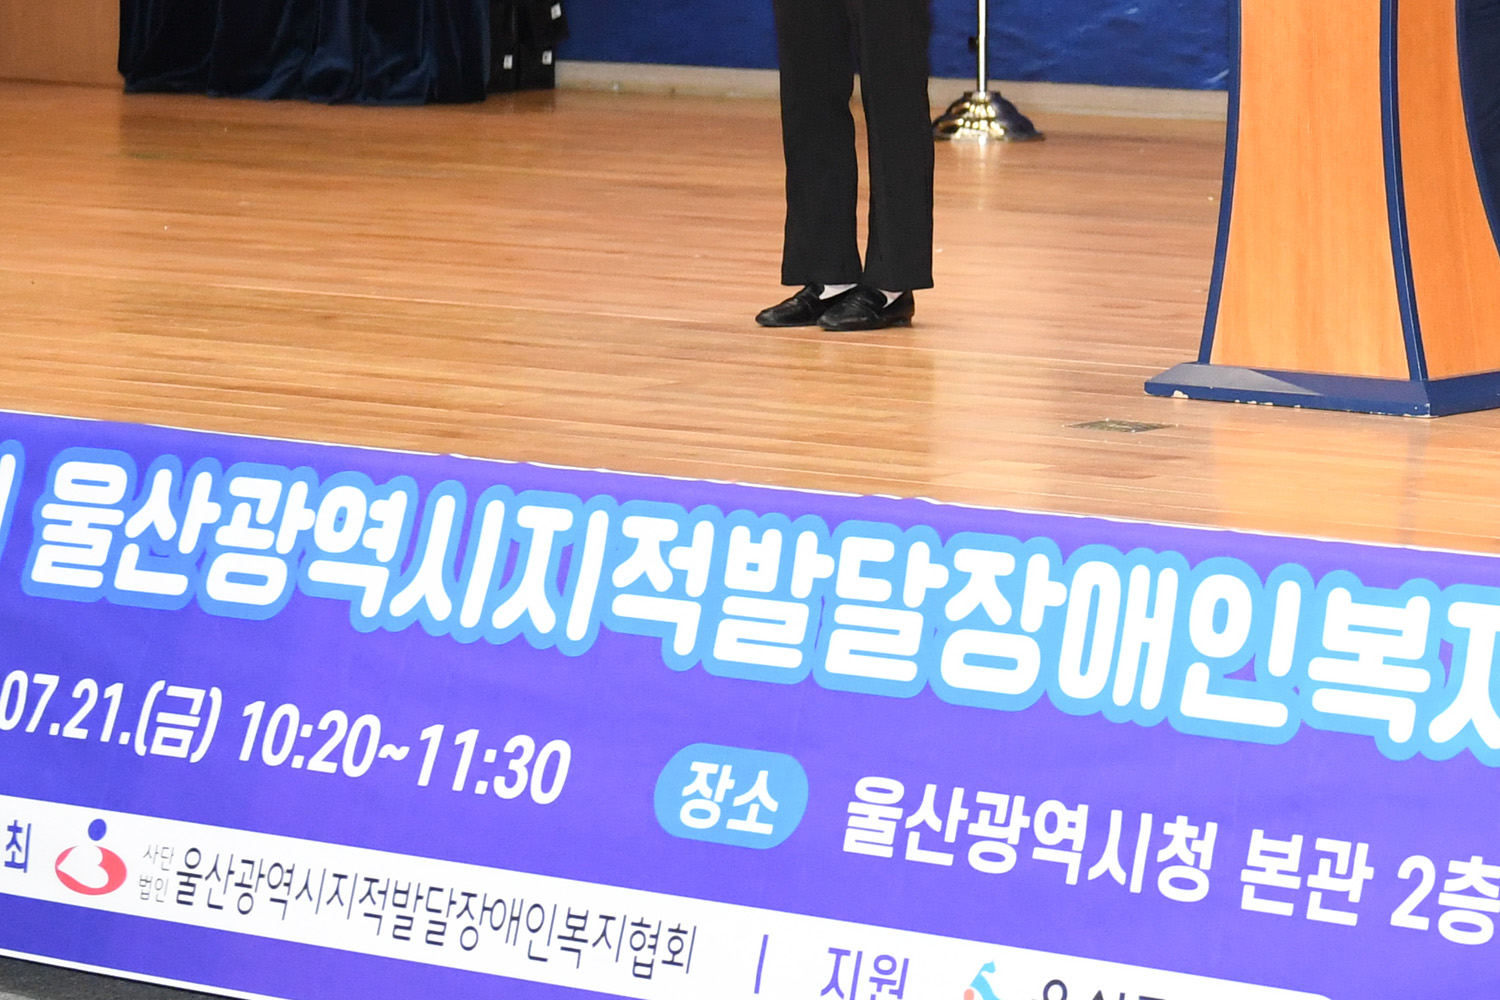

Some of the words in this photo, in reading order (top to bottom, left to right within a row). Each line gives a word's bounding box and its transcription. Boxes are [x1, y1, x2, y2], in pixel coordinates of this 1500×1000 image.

[238, 699, 572, 805] 10:20~11:30
[679, 760, 779, 836] 장소
[138, 873, 170, 903] 법인
[142, 843, 175, 872] 사단
[842, 776, 1218, 903] 울산광역시청
[1240, 828, 1375, 927] 본관
[175, 846, 697, 980] 울산광역시지적발달장애인복지협회
